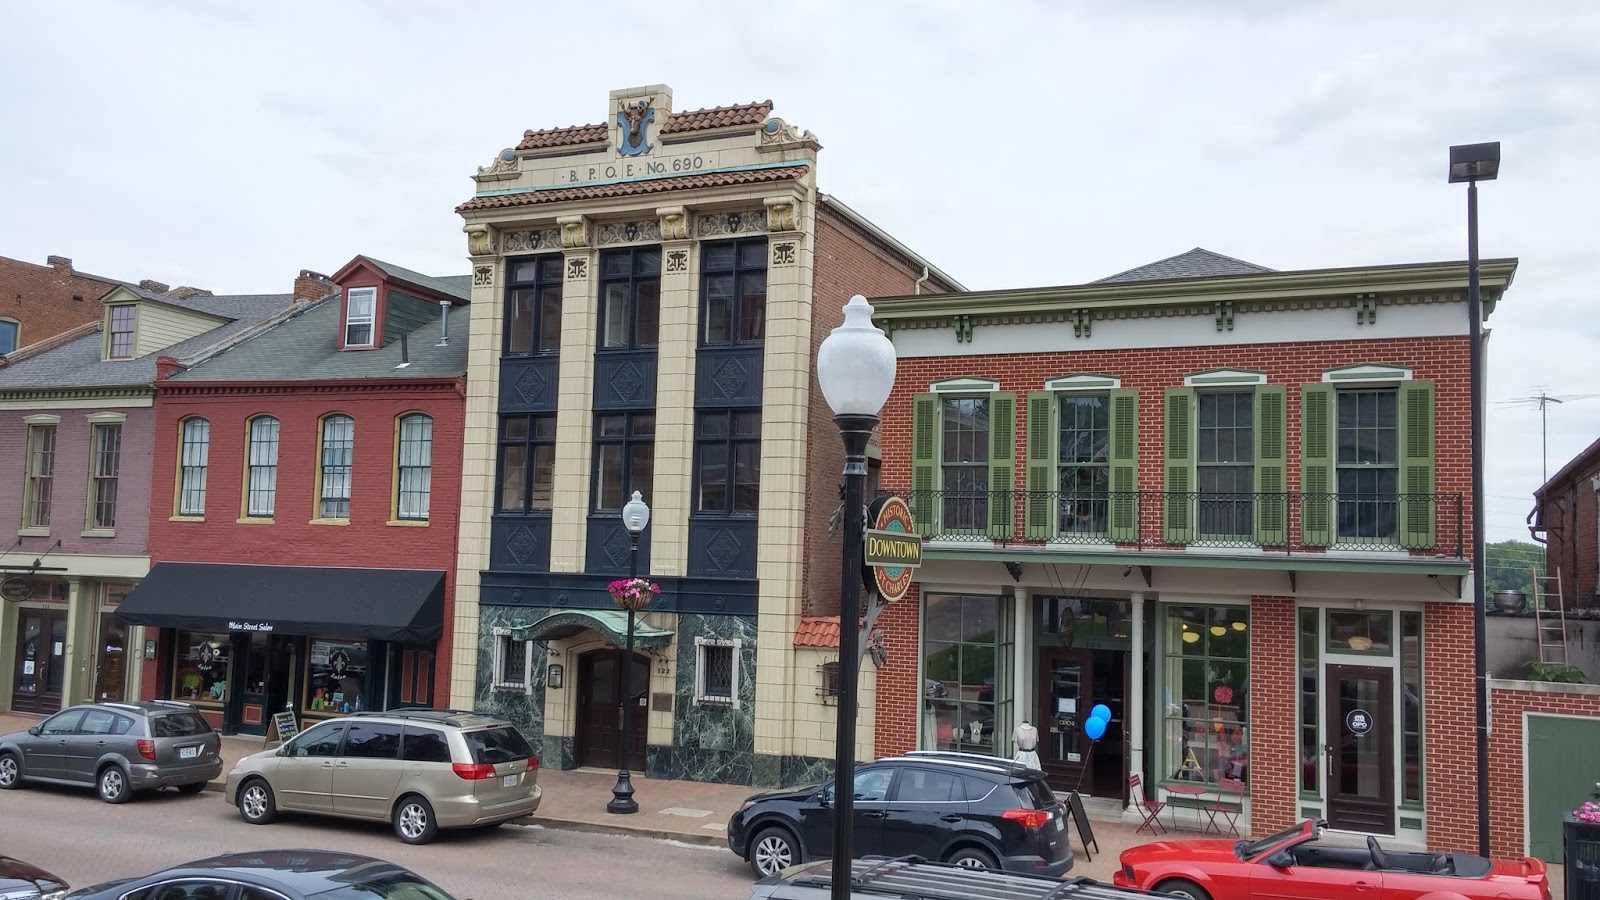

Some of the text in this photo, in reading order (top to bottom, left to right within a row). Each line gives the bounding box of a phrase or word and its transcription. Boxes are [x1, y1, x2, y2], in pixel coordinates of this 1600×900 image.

[647, 161, 667, 175] No.
[672, 156, 703, 172] 690
[882, 504, 910, 527] HISTORIC
[868, 537, 920, 559] DOWNTOWN
[885, 569, 910, 594] CHARLES
[228, 621, 273, 632] Main Street Salon
[657, 667, 670, 675] 122
